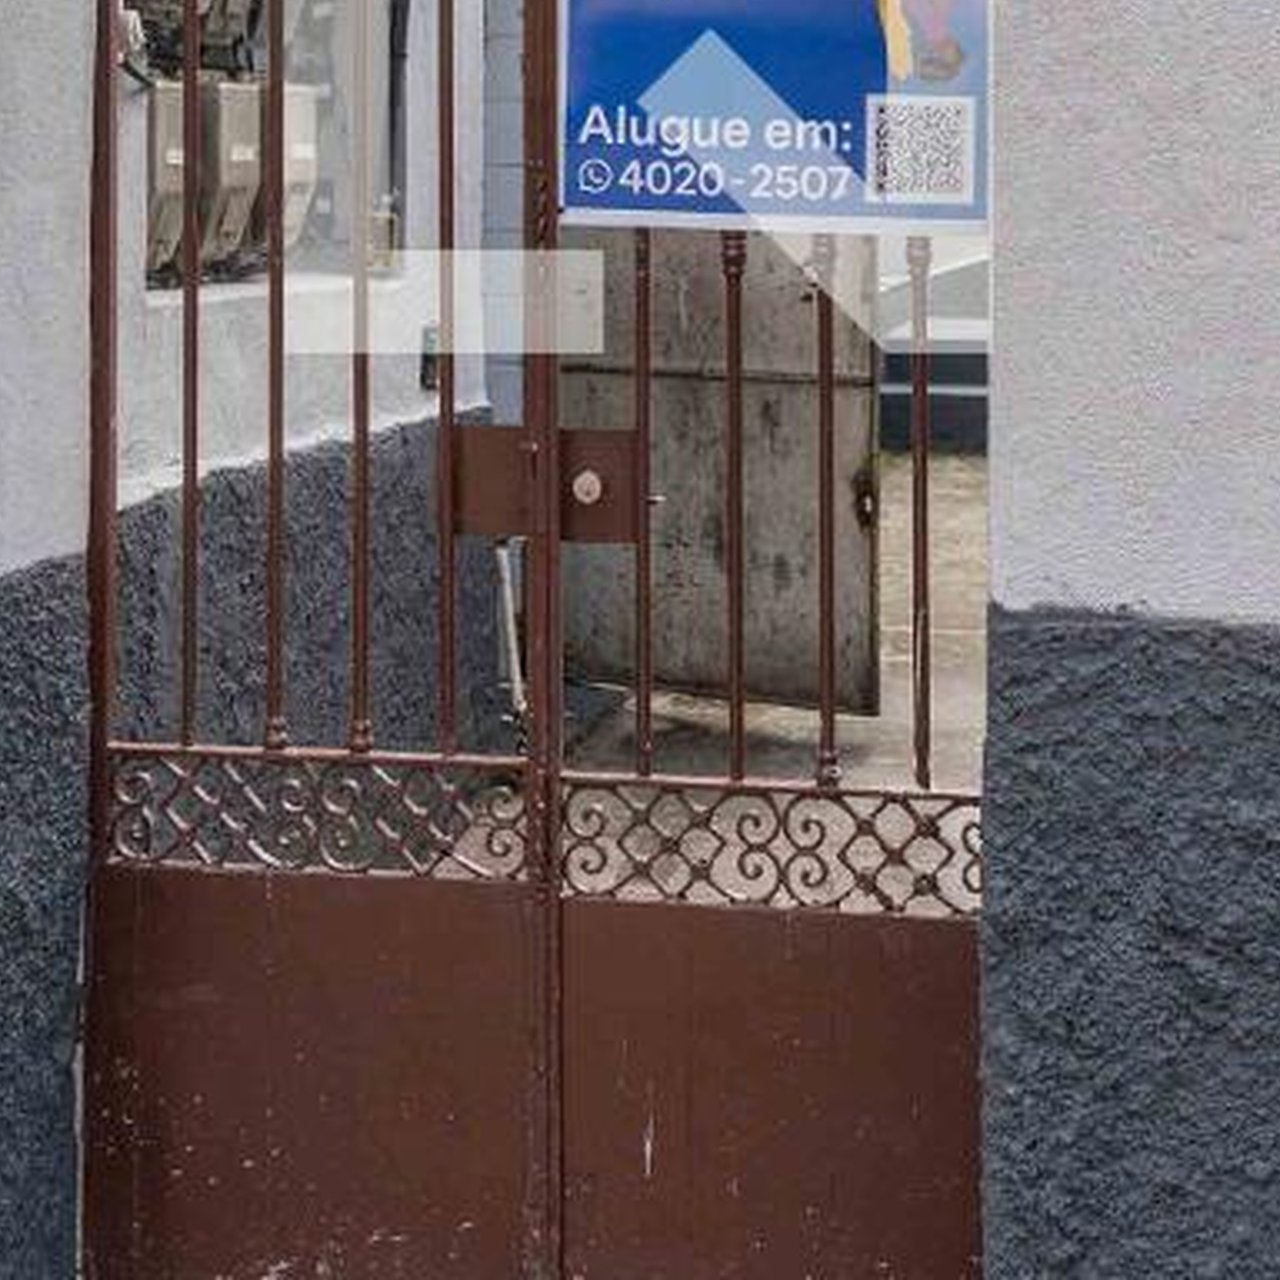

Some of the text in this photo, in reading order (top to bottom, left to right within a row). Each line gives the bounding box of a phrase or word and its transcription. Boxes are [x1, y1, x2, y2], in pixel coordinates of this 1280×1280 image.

[578, 104, 853, 156] Alugue em:
[618, 160, 853, 201] 4020-2507
